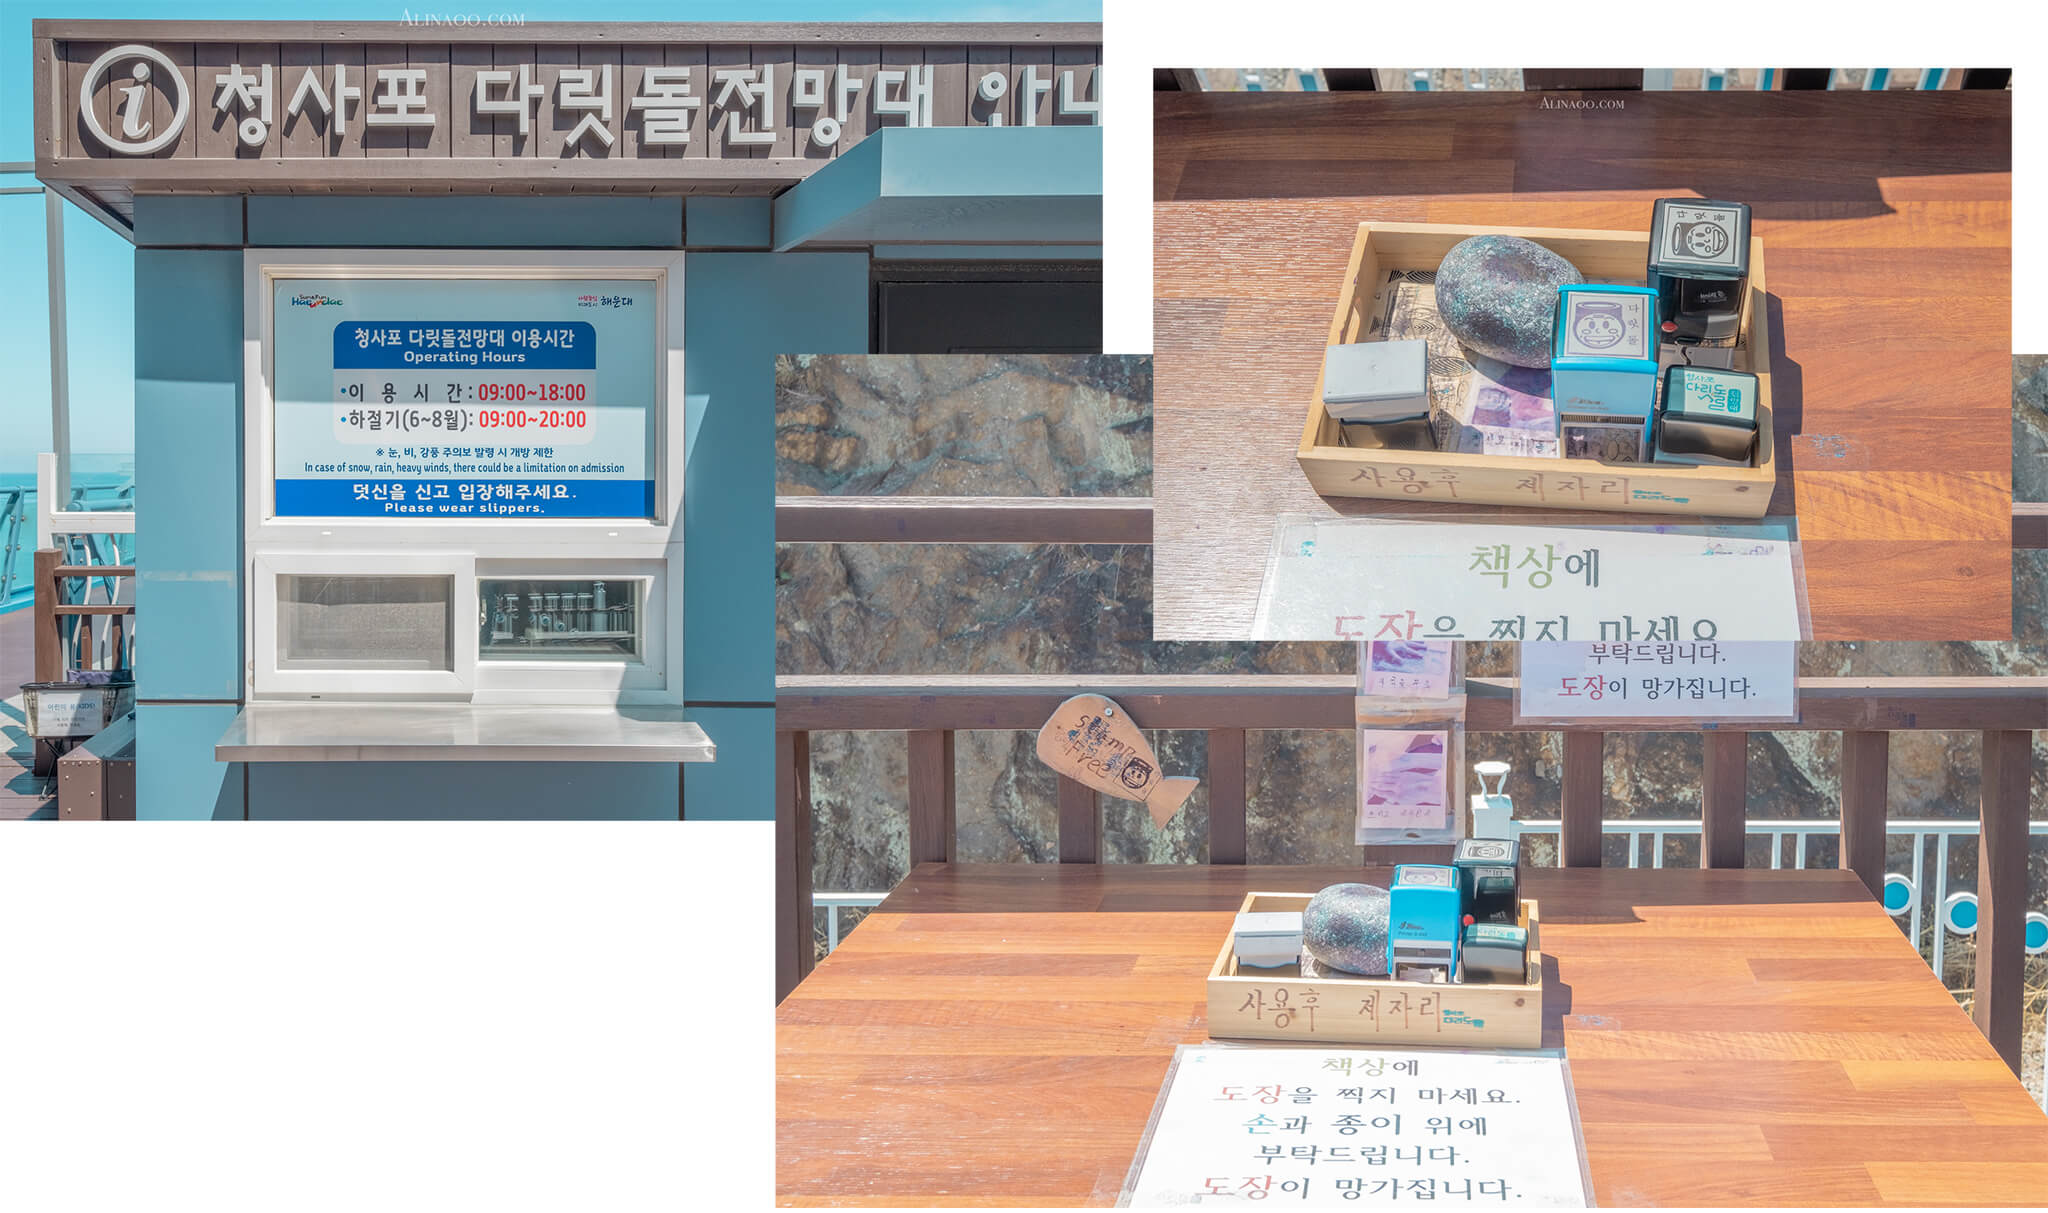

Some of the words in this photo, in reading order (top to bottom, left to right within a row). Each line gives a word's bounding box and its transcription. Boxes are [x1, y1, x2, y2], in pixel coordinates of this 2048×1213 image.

[215, 64, 436, 147] 청사포
[475, 63, 933, 147] 다릿돌전망대
[600, 295, 633, 308] 해운대
[355, 327, 402, 349] 청사포
[409, 327, 505, 349] 다릿돌전망대
[511, 328, 575, 349] 이용시간
[404, 351, 478, 365] Operating
[482, 351, 526, 363] Hours
[478, 383, 586, 401] 09:00~18:00
[479, 410, 586, 428] 09:00~20:00
[388, 448, 401, 458] 눈,
[404, 447, 417, 458] 비,
[420, 447, 439, 458] 강풍
[442, 447, 471, 458] 주의보
[474, 447, 495, 458] 발령
[498, 447, 507, 457] 시
[510, 447, 530, 458] 개방
[533, 447, 554, 458] 제한
[304, 462, 313, 472] In
[314, 463, 335, 472] case
[336, 462, 346, 472] of
[348, 463, 373, 474] snow,
[374, 462, 395, 474] rain,
[396, 462, 421, 475] heavy
[423, 462, 452, 474] winds,
[453, 462, 476, 473] there
[478, 462, 501, 473] could
[503, 462, 514, 473] be
[516, 464, 521, 473] a
[523, 462, 566, 473] limitation
[568, 464, 579, 473] on
[580, 462, 625, 473] admission
[1351, 466, 1459, 497] 사용후
[353, 484, 406, 501] 덧신을
[415, 484, 450, 501] 신고
[458, 484, 577, 501] 입장해주세요.
[385, 503, 434, 513] Please
[439, 504, 474, 513] wear
[479, 503, 545, 514] slippers.
[1469, 543, 1600, 589] 책상에
[1589, 643, 1727, 664] 부탁드립니다.
[1558, 674, 1627, 700] 도장이
[1642, 677, 1757, 700] 망가집니다.
[1238, 988, 1321, 1032] 사용후
[1321, 1057, 1419, 1077] 책상에
[1214, 1085, 1318, 1104] 도장을
[1336, 1087, 1396, 1104] 찍지
[1418, 1087, 1521, 1105] 마세요.
[1241, 1114, 1312, 1135] 손과
[1330, 1114, 1401, 1136] 종이
[1425, 1116, 1487, 1136] 위에
[1253, 1145, 1470, 1166] 부탁드립니다.
[1203, 1175, 1310, 1200] 도장이
[1335, 1177, 1522, 1201] 망가집니다.
